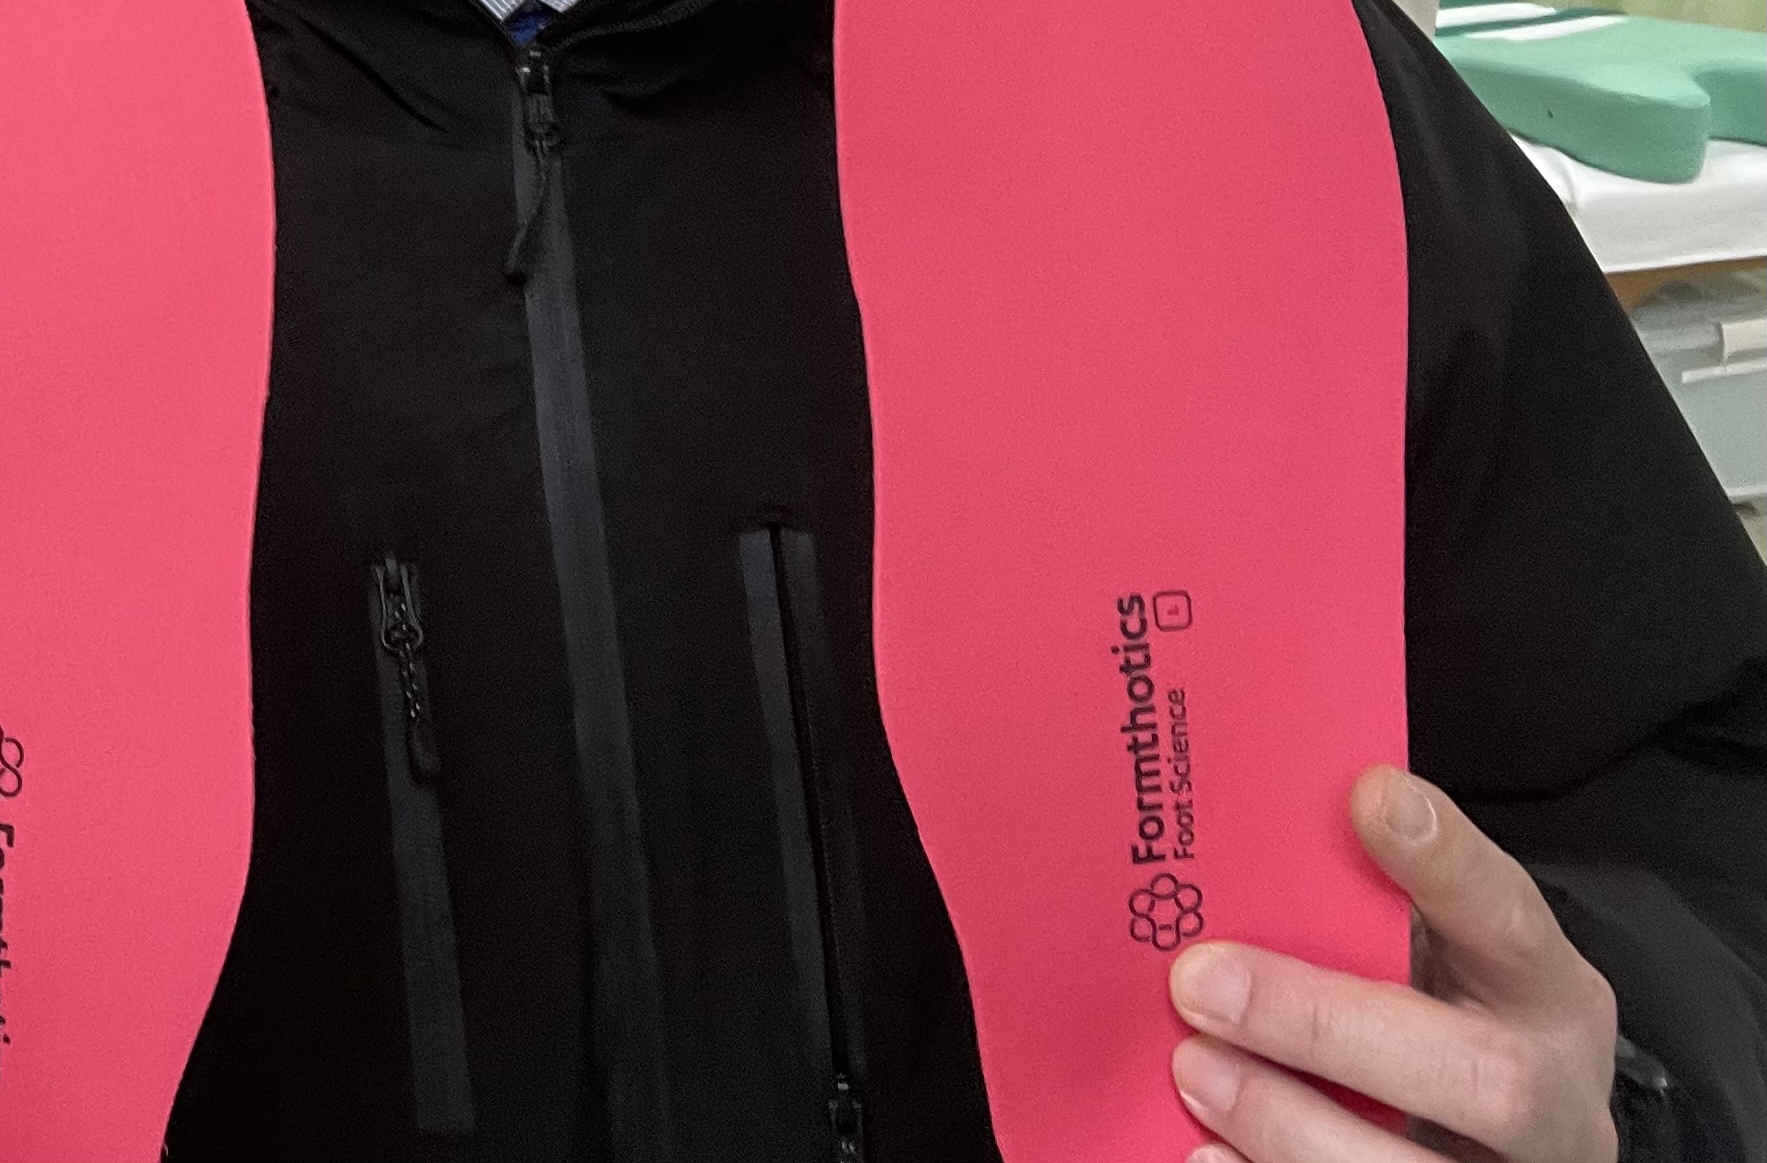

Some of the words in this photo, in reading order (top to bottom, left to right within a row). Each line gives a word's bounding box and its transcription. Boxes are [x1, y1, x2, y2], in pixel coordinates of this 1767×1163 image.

[1111, 593, 1167, 864] Formthotics
[1168, 688, 1194, 794] Science
[1173, 801, 1196, 861] Foot
